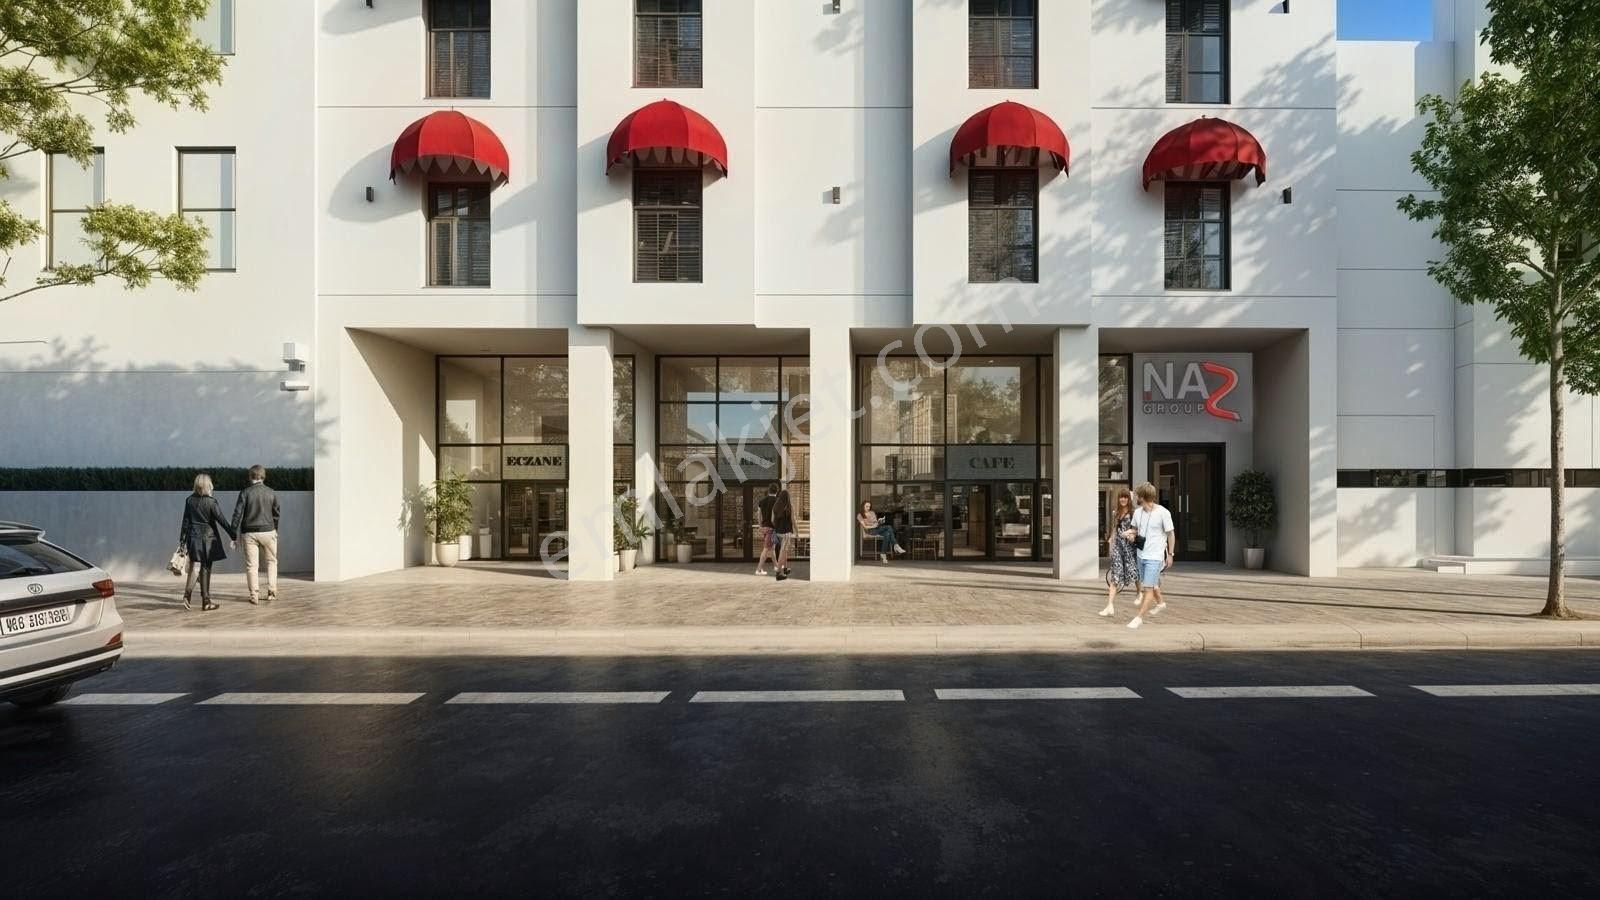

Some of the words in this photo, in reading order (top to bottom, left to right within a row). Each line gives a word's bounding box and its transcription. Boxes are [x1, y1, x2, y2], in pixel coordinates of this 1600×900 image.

[1143, 403, 1205, 414] GROUP
[506, 456, 562, 466] ECZANE
[968, 456, 1015, 469] CAFE
